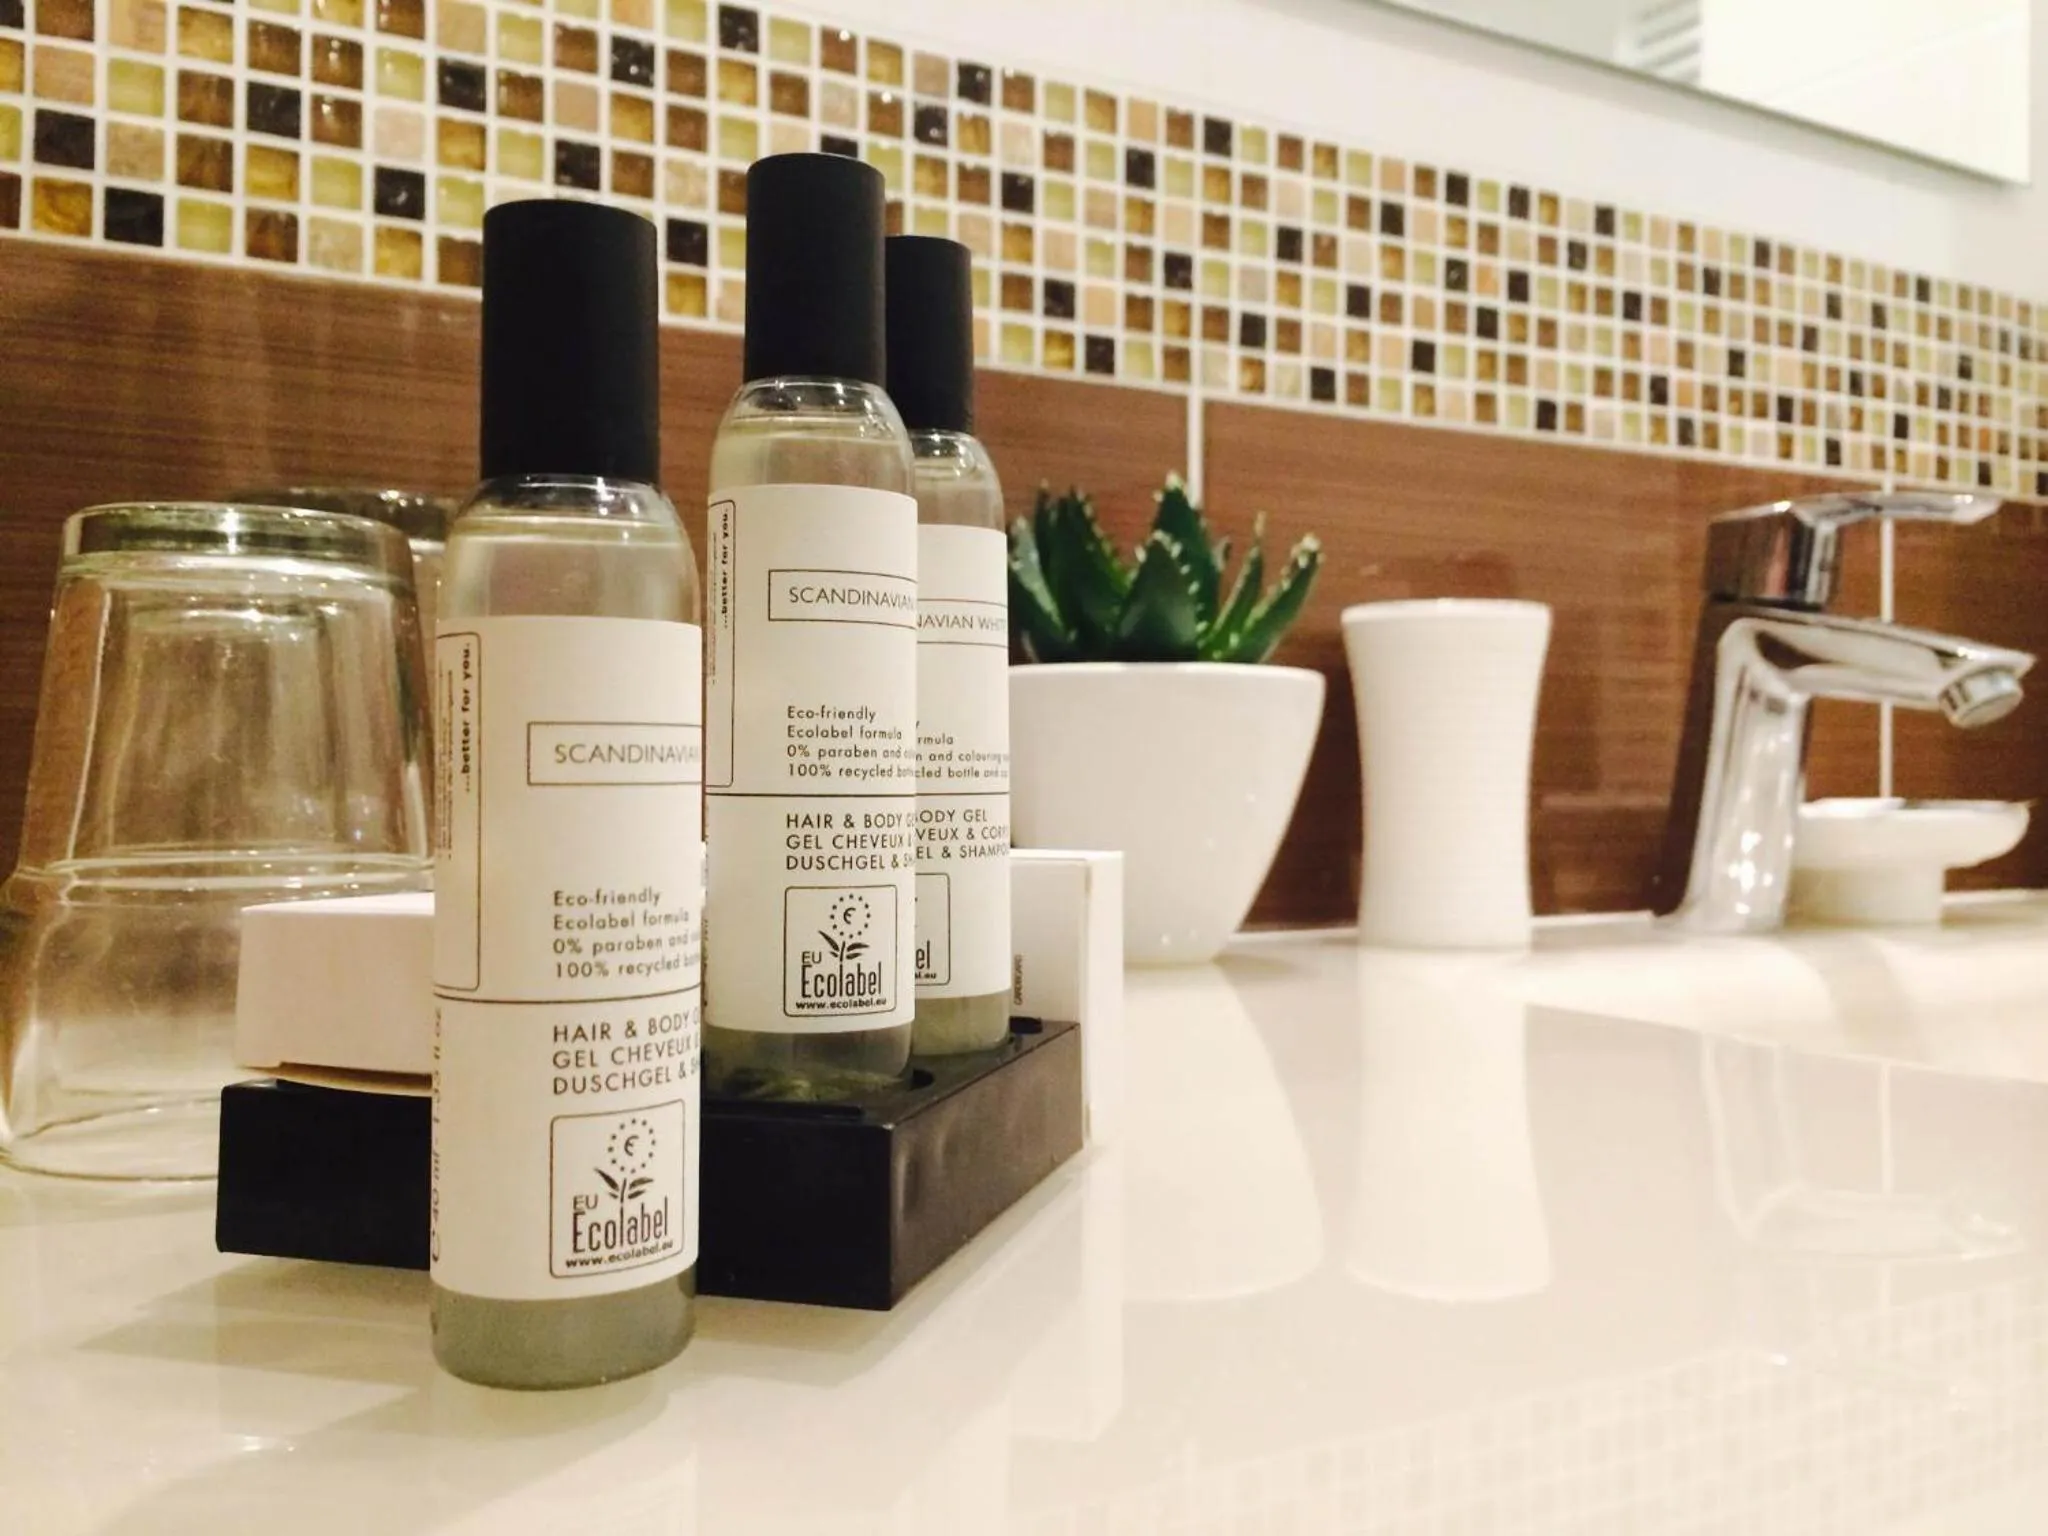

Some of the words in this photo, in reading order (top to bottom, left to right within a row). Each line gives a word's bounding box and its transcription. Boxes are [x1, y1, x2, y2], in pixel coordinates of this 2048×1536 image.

[461, 687, 470, 713] for
[787, 704, 877, 724] Eco-friendly
[787, 723, 853, 738] Ecolabel
[860, 725, 902, 740] formula
[786, 743, 810, 758] 0%
[818, 744, 878, 761] paraben
[882, 746, 902, 759] and
[929, 750, 953, 762] and
[788, 763, 832, 777] 100%
[838, 763, 894, 781] recycled
[948, 766, 980, 778] bottle
[786, 813, 833, 829] HAIR
[843, 812, 855, 829] &
[863, 812, 903, 829] BODY
[916, 808, 956, 824] ODY
[963, 808, 988, 823] GEL
[786, 833, 823, 850] GEL
[832, 833, 904, 850] CHEVEUX
[966, 827, 975, 841] &
[941, 845, 952, 859] &
[786, 854, 886, 871] DUSCHGEL
[891, 853, 900, 869] &
[553, 885, 661, 907] Eco-friendly
[553, 909, 636, 931] Ecolabel
[643, 907, 690, 928] formula
[553, 937, 584, 955] 0%
[592, 934, 664, 958] paraben
[556, 961, 610, 979] 100%
[618, 953, 681, 977] recycled
[801, 950, 822, 964] EU
[801, 960, 882, 999] Ecolabel
[795, 997, 887, 1010] www.ecolabel.eu
[553, 1021, 612, 1043] HAIR
[624, 1019, 638, 1039] &
[648, 1009, 690, 1037] BODY
[552, 1049, 600, 1070] GEL
[610, 1033, 693, 1066] CHEVEUX
[553, 1065, 672, 1096] DUSCHGEL
[678, 1060, 687, 1079] &
[572, 1193, 599, 1211] EU
[572, 1194, 669, 1254] Ecolabel
[565, 1239, 674, 1269] www.ecolabel.eu
